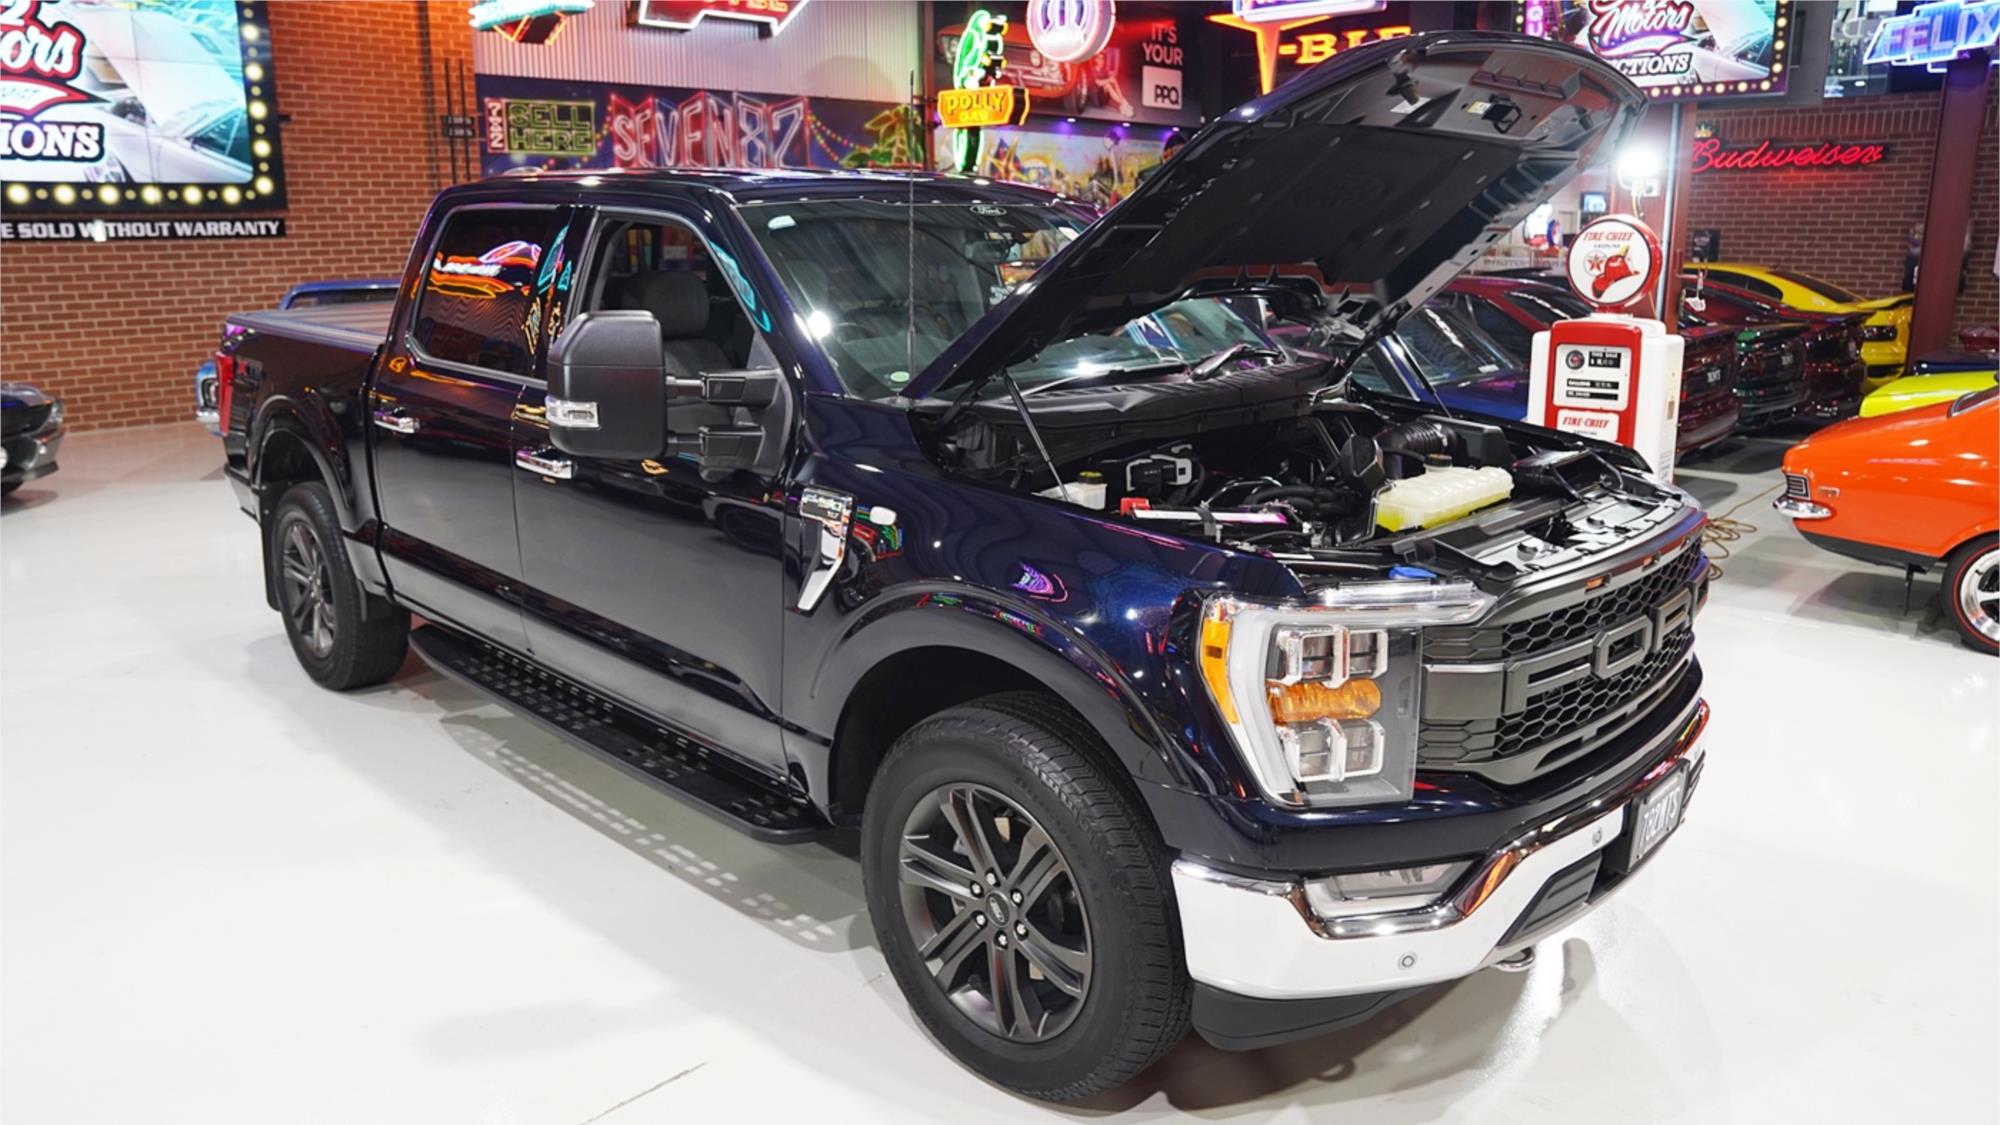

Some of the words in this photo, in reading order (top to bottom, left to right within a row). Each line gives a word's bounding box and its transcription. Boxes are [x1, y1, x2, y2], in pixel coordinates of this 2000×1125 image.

[1152, 23, 1177, 43] IT'S
[1593, 2, 1690, 47] Motors
[1885, 5, 1999, 54] FELIX
[1142, 43, 1183, 65] YOUR
[1611, 55, 1690, 76] CTIONS
[946, 92, 1006, 116] POLLY
[1154, 85, 1179, 105] PPQ
[509, 104, 590, 129] SELL
[959, 110, 989, 122] GAS
[511, 129, 592, 150] HERE
[1691, 138, 1884, 173] Budweiser
[17, 222, 75, 239] SOLD
[78, 221, 170, 238] WTHOUT
[173, 220, 279, 238] WARRANTY
